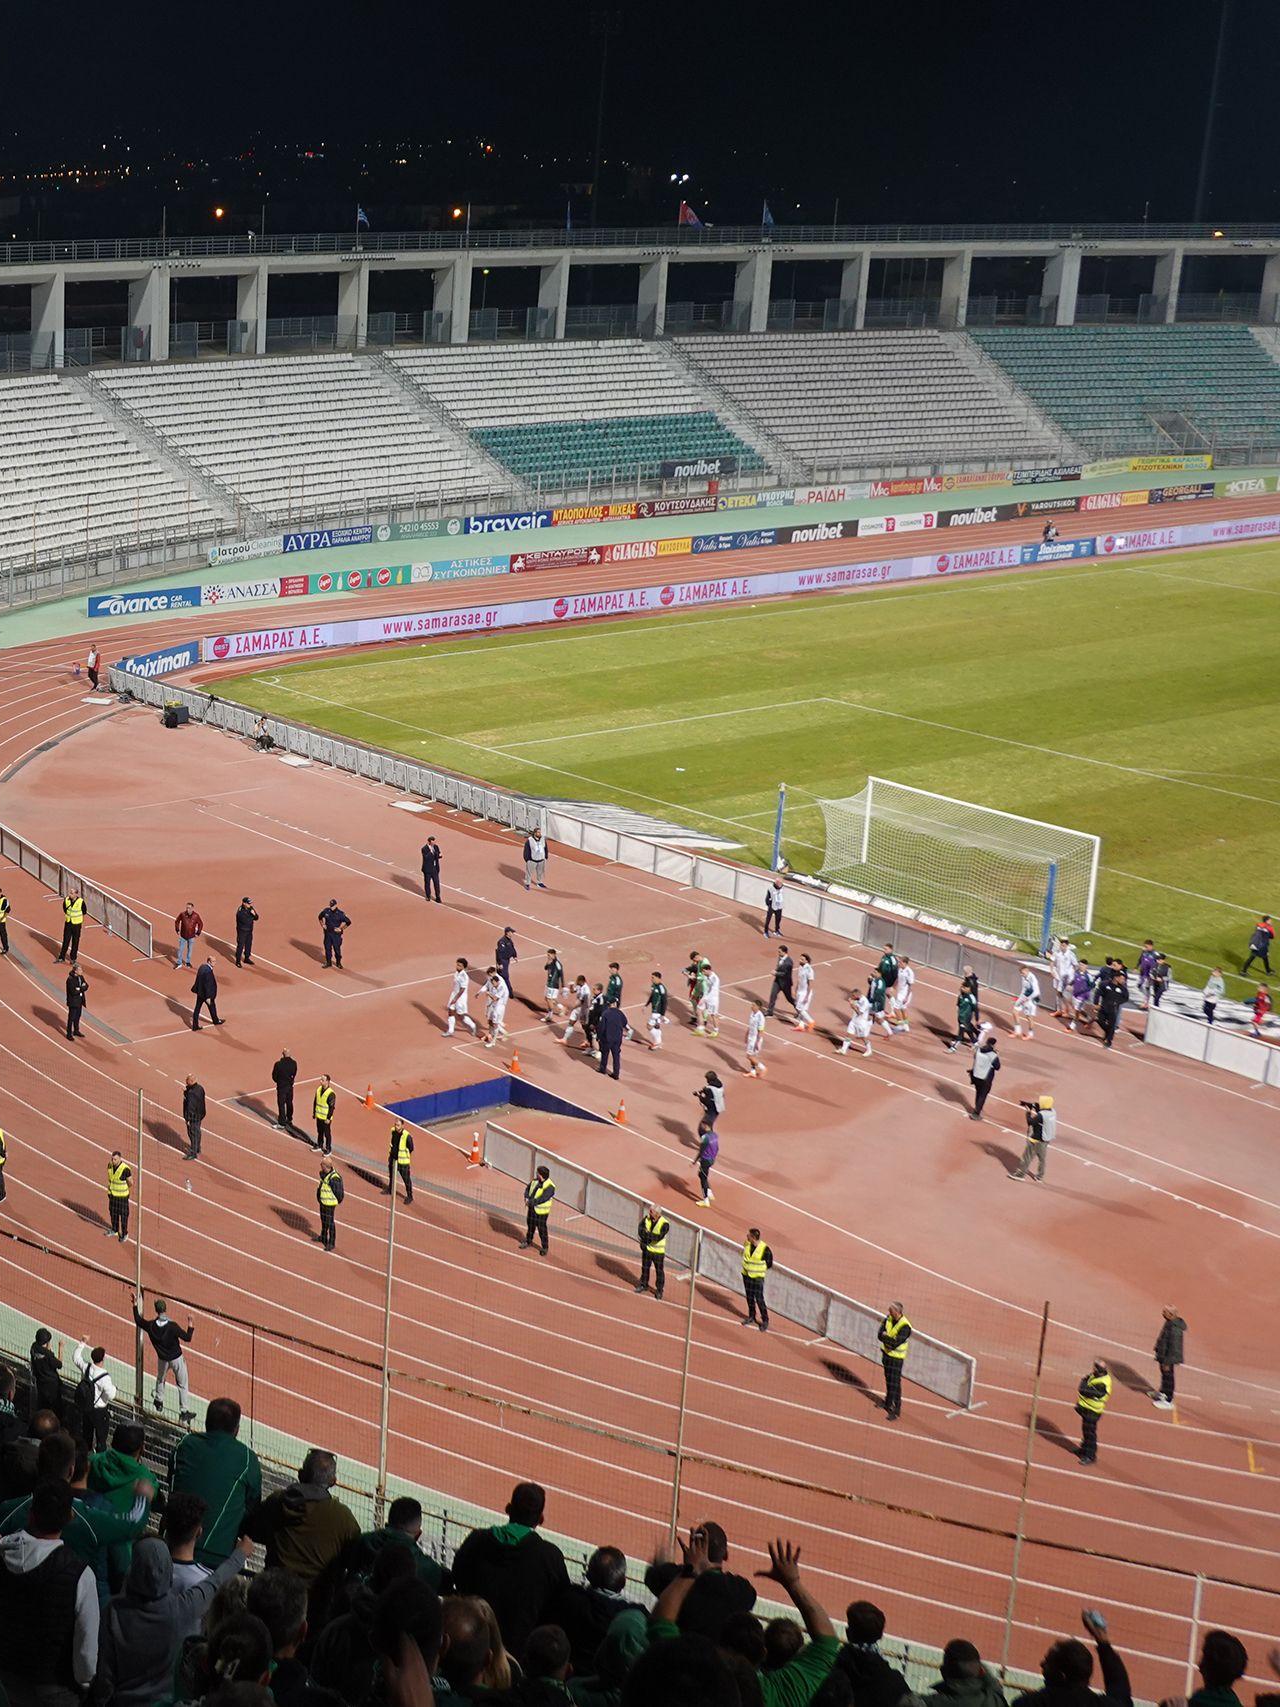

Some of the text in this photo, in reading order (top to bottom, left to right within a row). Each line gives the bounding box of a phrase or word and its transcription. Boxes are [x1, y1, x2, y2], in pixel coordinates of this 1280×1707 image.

[673, 461, 721, 477] novibet
[654, 497, 716, 511] ΚΟΥΤΣΟΥΔΑΚΗΣ
[469, 511, 548, 534] bravair
[949, 507, 997, 526] novibet
[399, 523, 419, 533] 24210
[791, 522, 843, 543] novibet
[218, 542, 250, 556] Ιατρού
[285, 531, 332, 552] ΑΥΡΑ
[450, 557, 493, 569] ΑΣΤΙΚΕΣ
[526, 547, 588, 560] ΚΕΝΤΑΥΡΟΣ
[953, 551, 996, 571] ΣΑΜΑΡΑΣ
[433, 565, 508, 580] ΣΥΓΚΟΙΝΩΝΙΕΣ
[798, 564, 892, 586] www.samarasae.gr
[227, 583, 278, 599] ΑΝΑΣΣΑ
[679, 581, 727, 602] ΣΑΜΑΡΑΣ
[109, 595, 168, 615] avance
[170, 601, 193, 609] RENTAL
[573, 593, 624, 615] ΣΑΜΑΡΑΣ
[383, 610, 499, 635] www.samarasae.gr
[235, 630, 294, 654] ΣΑΜΑΡΑΣ
[125, 650, 191, 678] Stoiximan
